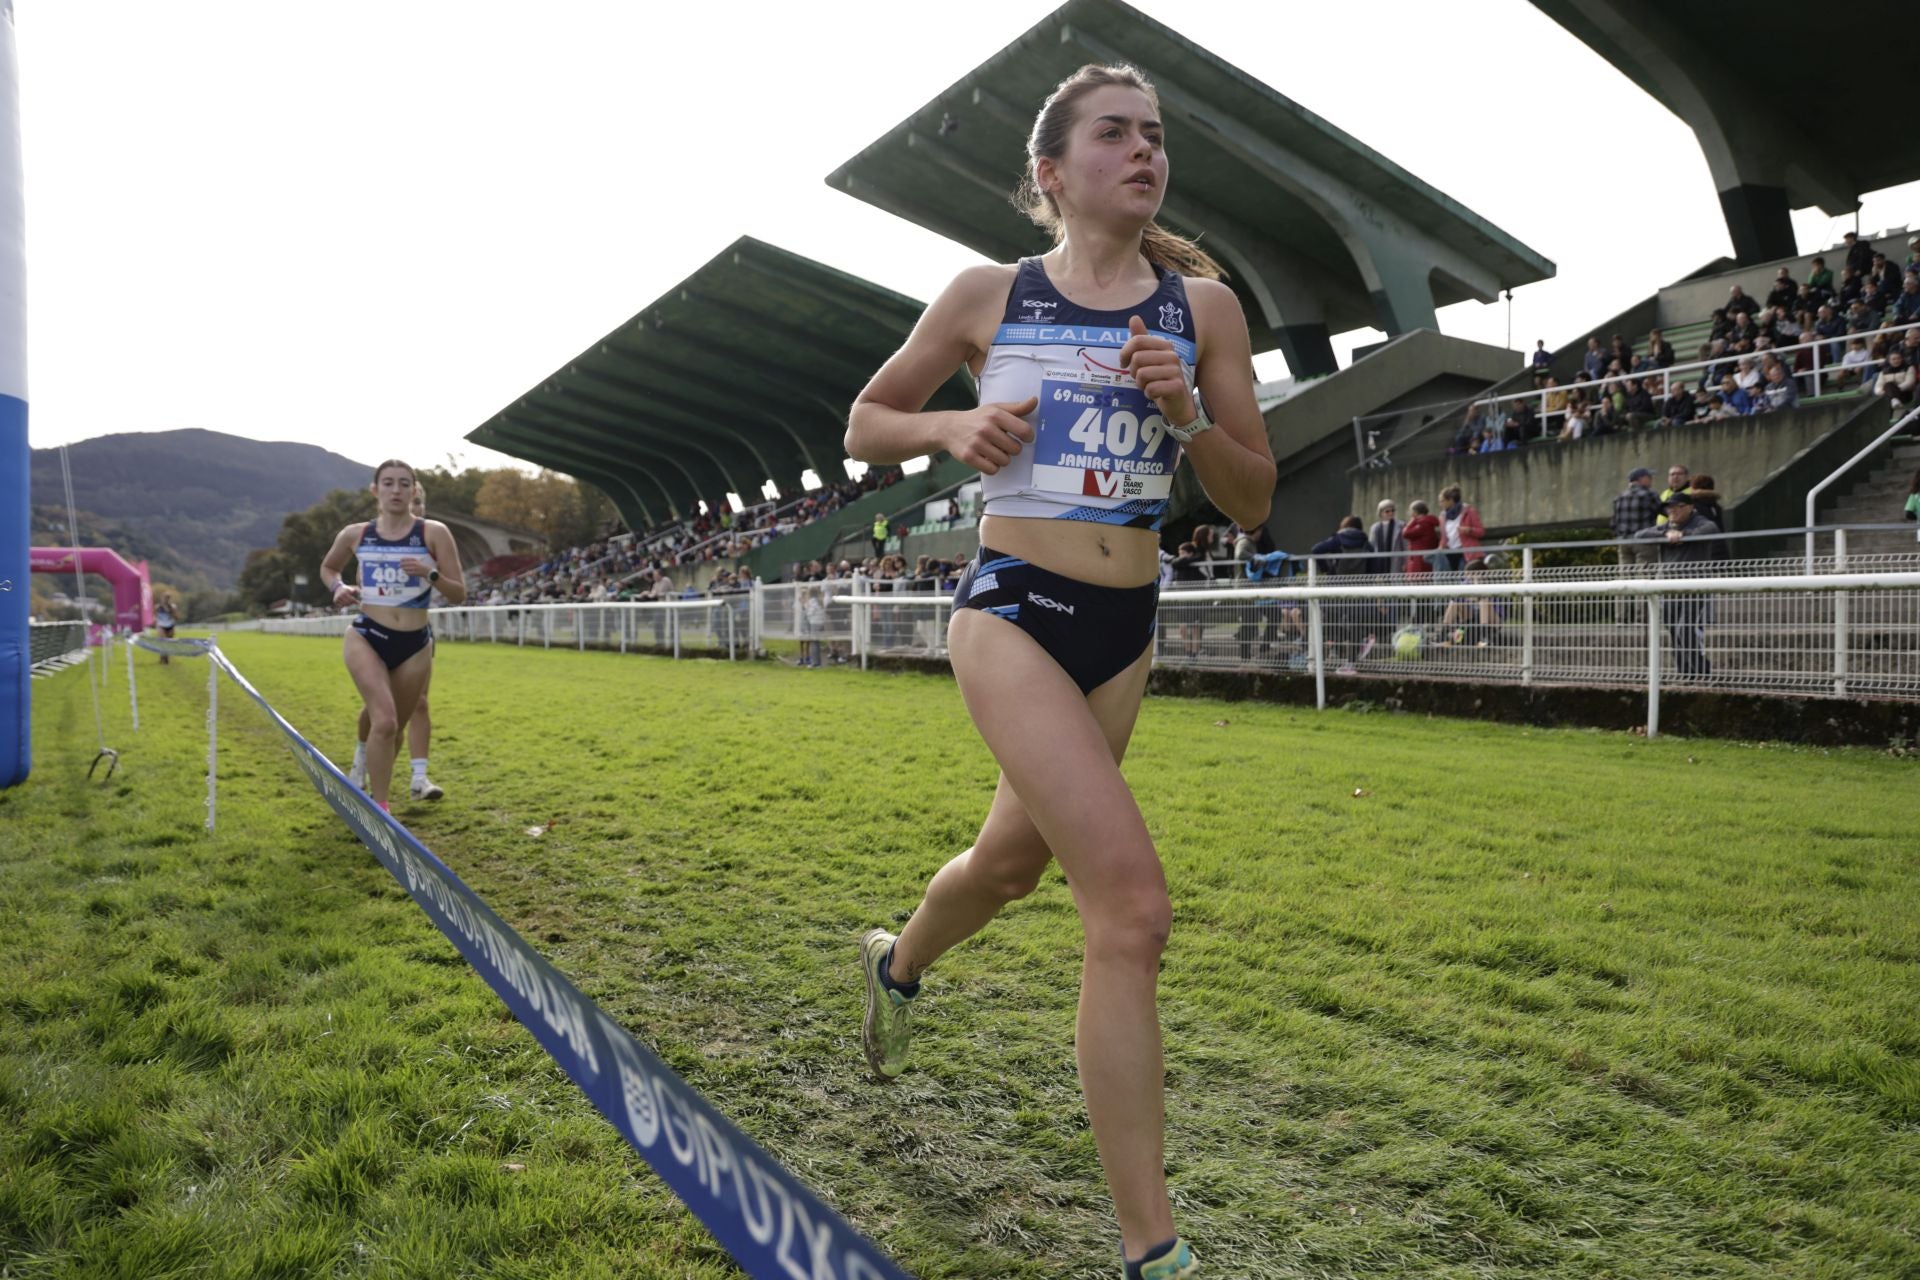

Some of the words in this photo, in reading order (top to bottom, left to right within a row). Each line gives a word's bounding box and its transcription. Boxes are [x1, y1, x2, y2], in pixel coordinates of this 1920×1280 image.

[1053, 388, 1072, 402] 69
[1069, 407, 1166, 458] 409
[1057, 453, 1110, 470] JANIRE
[1114, 459, 1164, 475] VELASCO
[1123, 481, 1144, 489] DIARIO
